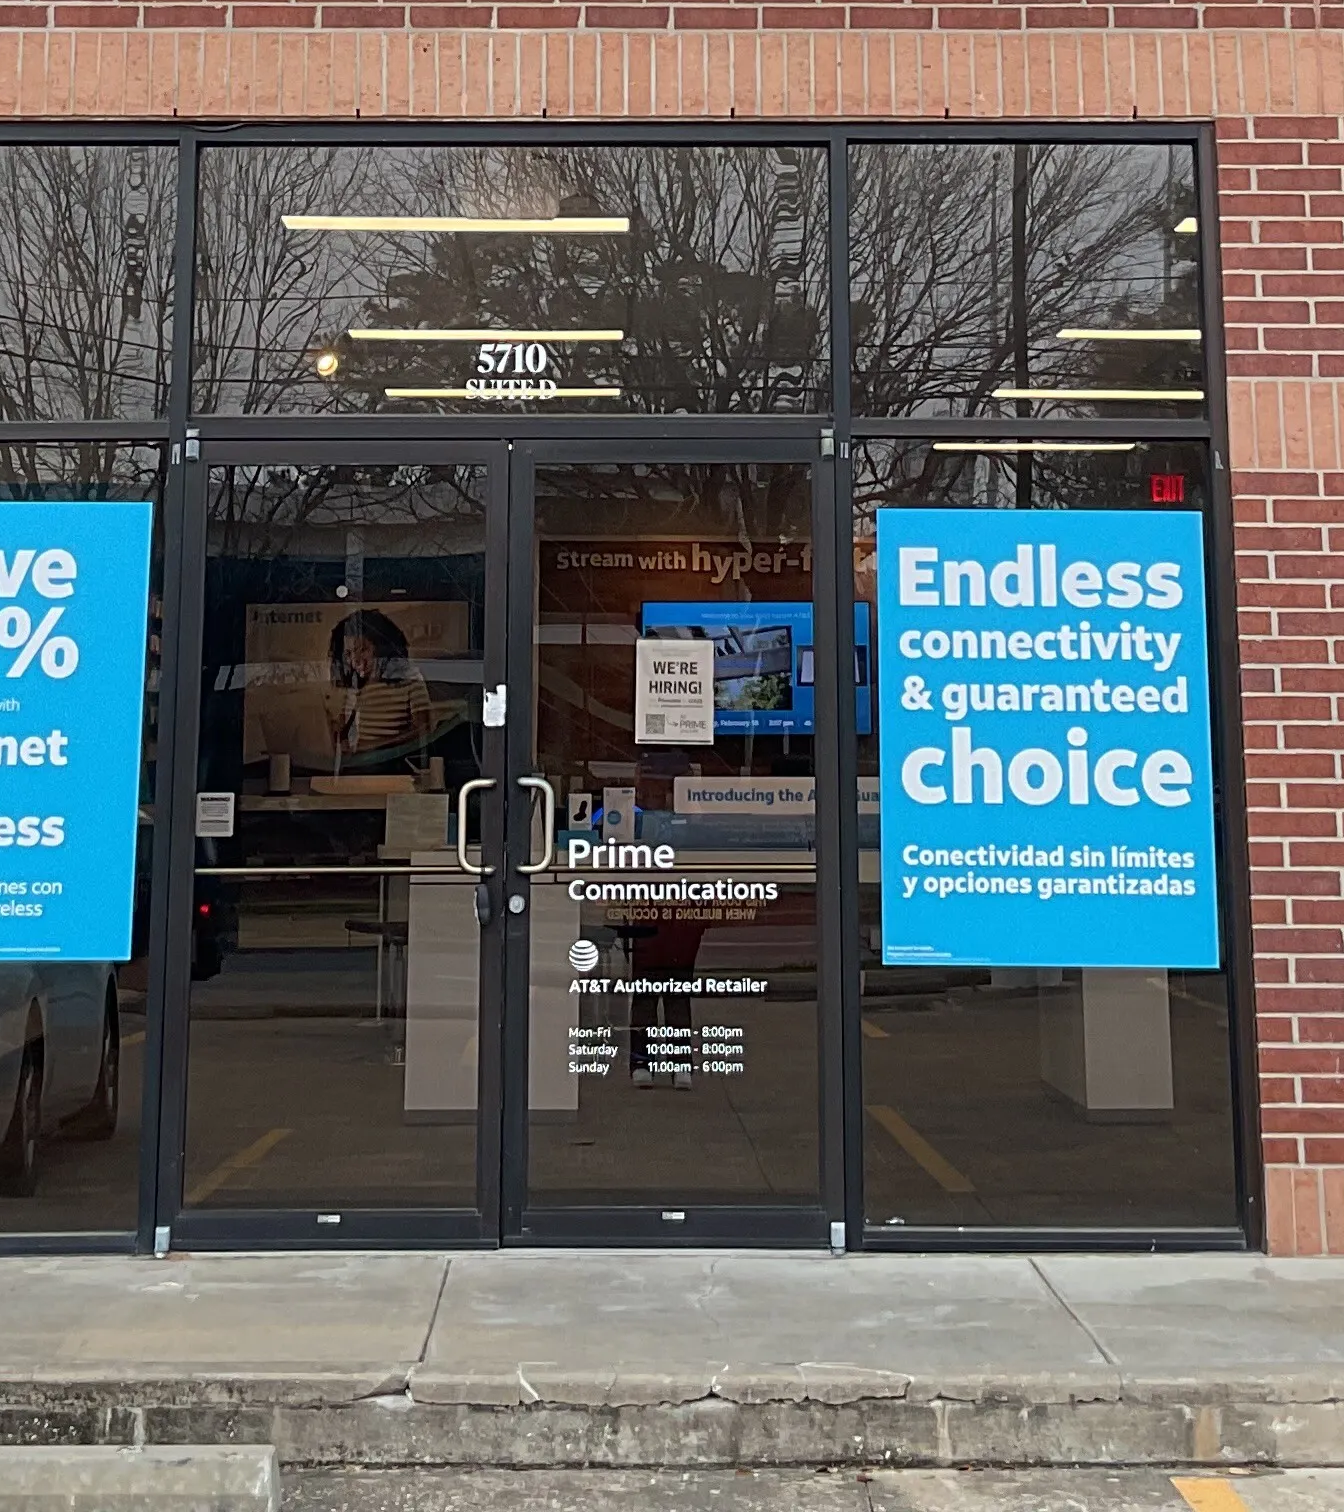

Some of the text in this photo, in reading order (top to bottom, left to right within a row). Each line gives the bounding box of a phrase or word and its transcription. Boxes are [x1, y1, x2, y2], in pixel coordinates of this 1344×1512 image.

[477, 343, 546, 373] 5710
[464, 378, 557, 399] SUITE D
[1152, 475, 1184, 502] EXIT
[556, 551, 633, 569] Stream
[638, 550, 687, 569] with
[898, 544, 1183, 608] Endless
[899, 621, 1182, 670] connectivity
[653, 661, 698, 675] WE'RE
[649, 680, 702, 695] HIRING!
[901, 675, 1188, 720] & guaranteed
[901, 726, 1193, 806] choice
[687, 788, 774, 805] Introducing
[778, 789, 803, 802] the
[569, 837, 674, 868] Prime
[902, 845, 1195, 868] Conectividad sin límites
[31, 882, 62, 895] con
[568, 879, 777, 901] Communications
[902, 871, 1195, 899] y opciones garantizadas
[569, 978, 767, 993] AT&T Authorized Retailer
[569, 1026, 611, 1037] Mon-Fri
[645, 1026, 691, 1037] 10:00am
[702, 1026, 743, 1039] 8:00pm
[569, 1044, 618, 1058] Saturday
[645, 1044, 691, 1055] 10:00am
[702, 1044, 743, 1057] 8:00pm
[569, 1061, 610, 1076] Sunday
[702, 1061, 744, 1075] 6:00pm
